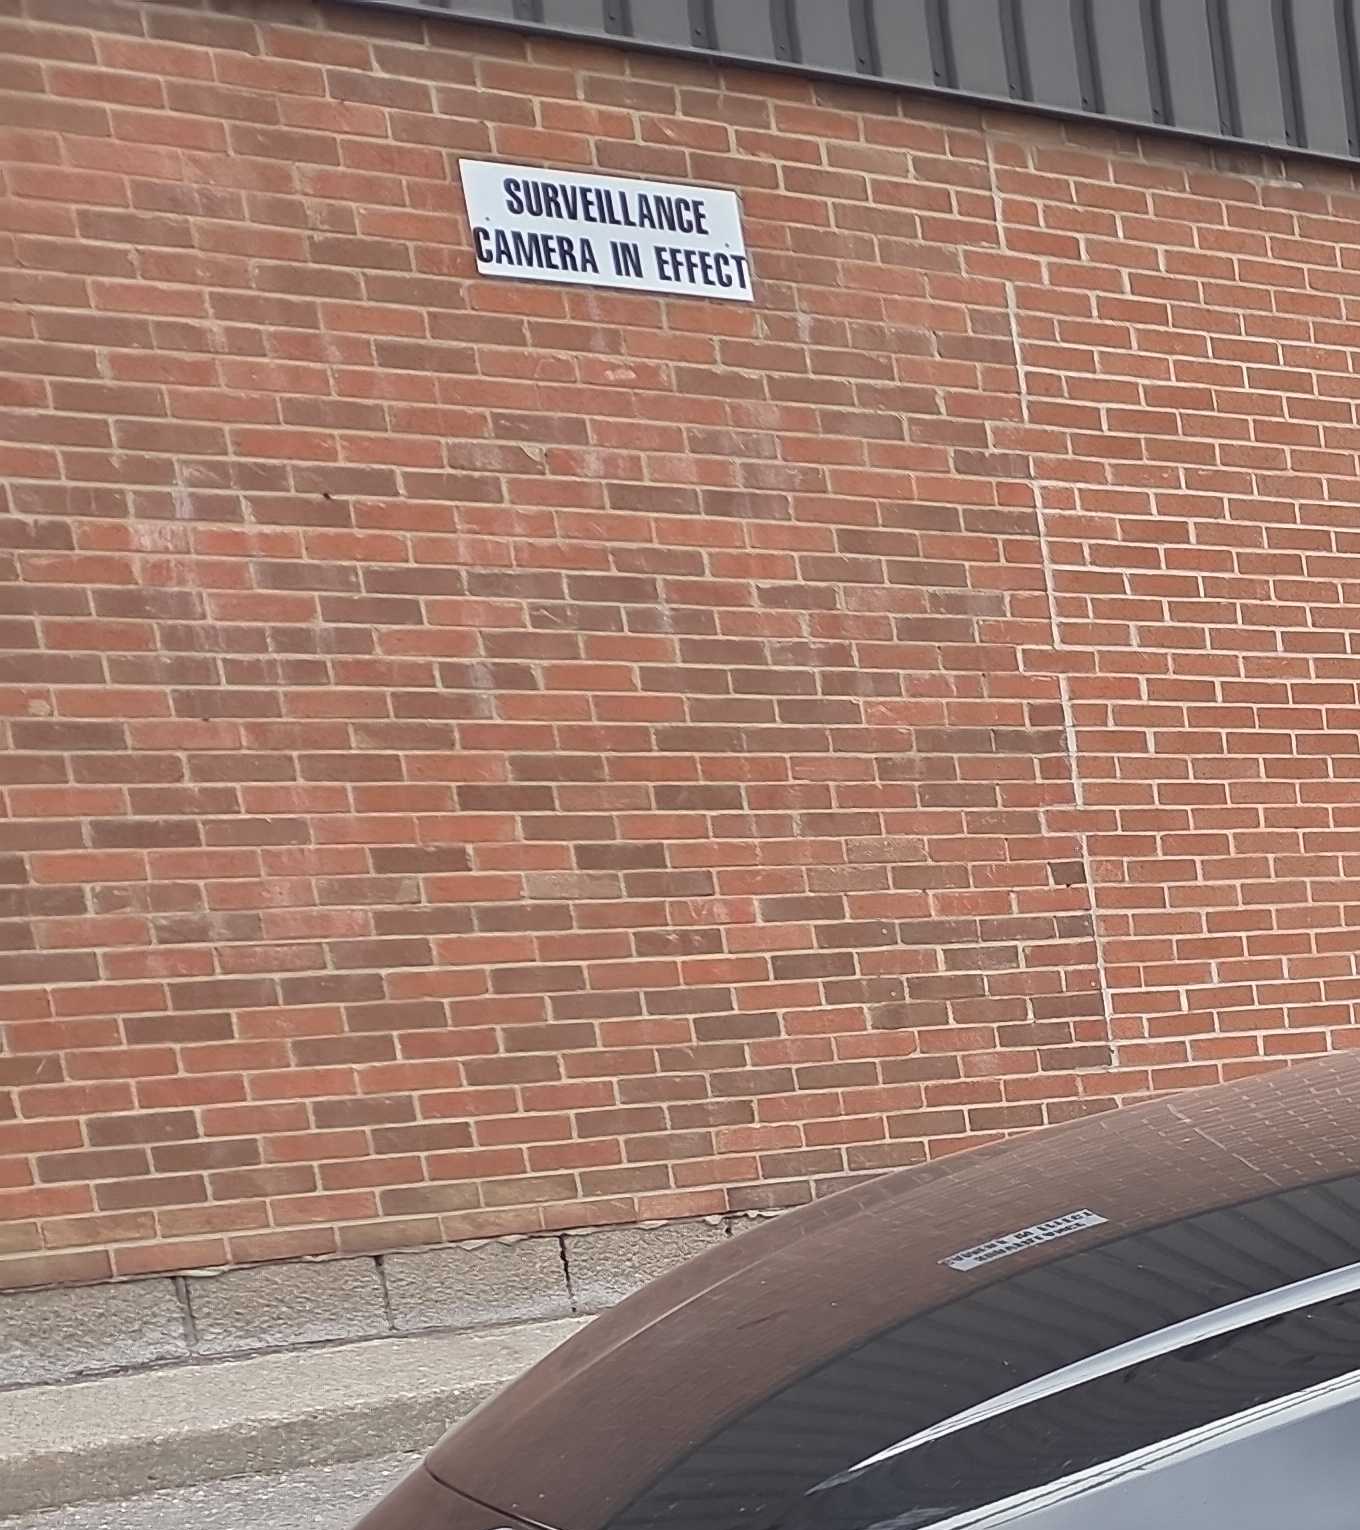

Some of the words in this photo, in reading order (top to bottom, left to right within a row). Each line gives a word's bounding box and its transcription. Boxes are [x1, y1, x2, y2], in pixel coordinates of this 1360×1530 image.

[503, 177, 707, 235] SURVEILLANCE
[474, 226, 600, 274] CAMERA
[610, 241, 643, 278] IN
[655, 246, 748, 289] EFFECT
